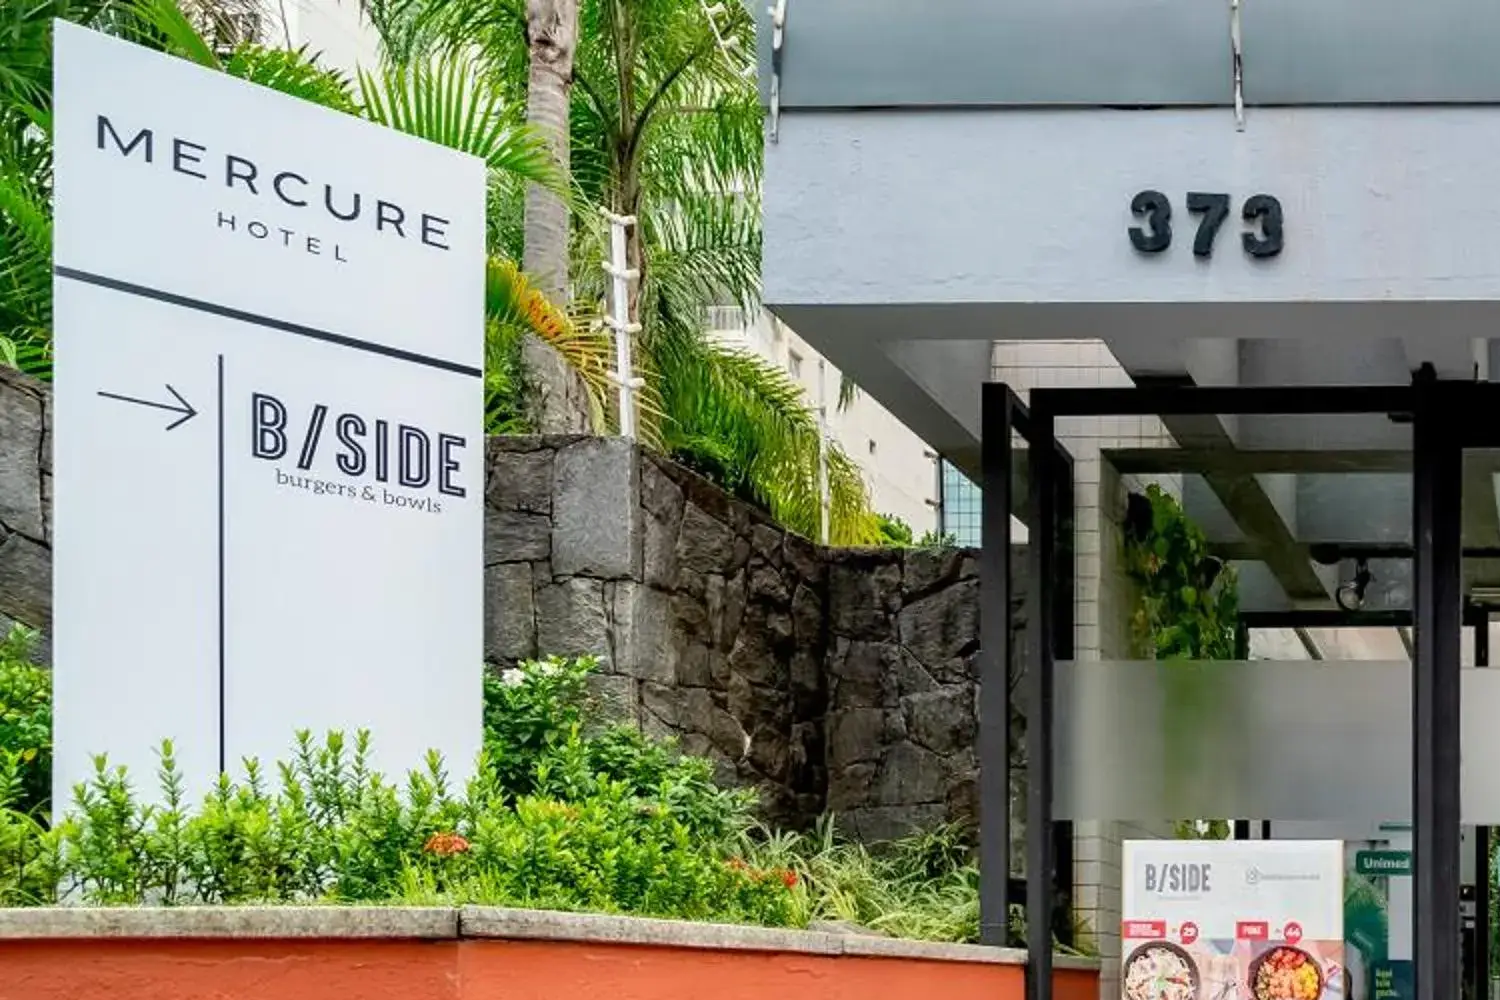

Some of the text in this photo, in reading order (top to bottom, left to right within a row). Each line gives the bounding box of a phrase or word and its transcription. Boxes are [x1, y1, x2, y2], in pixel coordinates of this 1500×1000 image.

[96, 114, 451, 251] MERCURE
[217, 211, 348, 263] HOTEL
[1128, 189, 1284, 258] 373
[251, 392, 468, 499] B/SIDE
[275, 467, 442, 514] burgers & bowls
[1145, 863, 1212, 893] B/SIDE
[1363, 856, 1411, 870] Unimed
